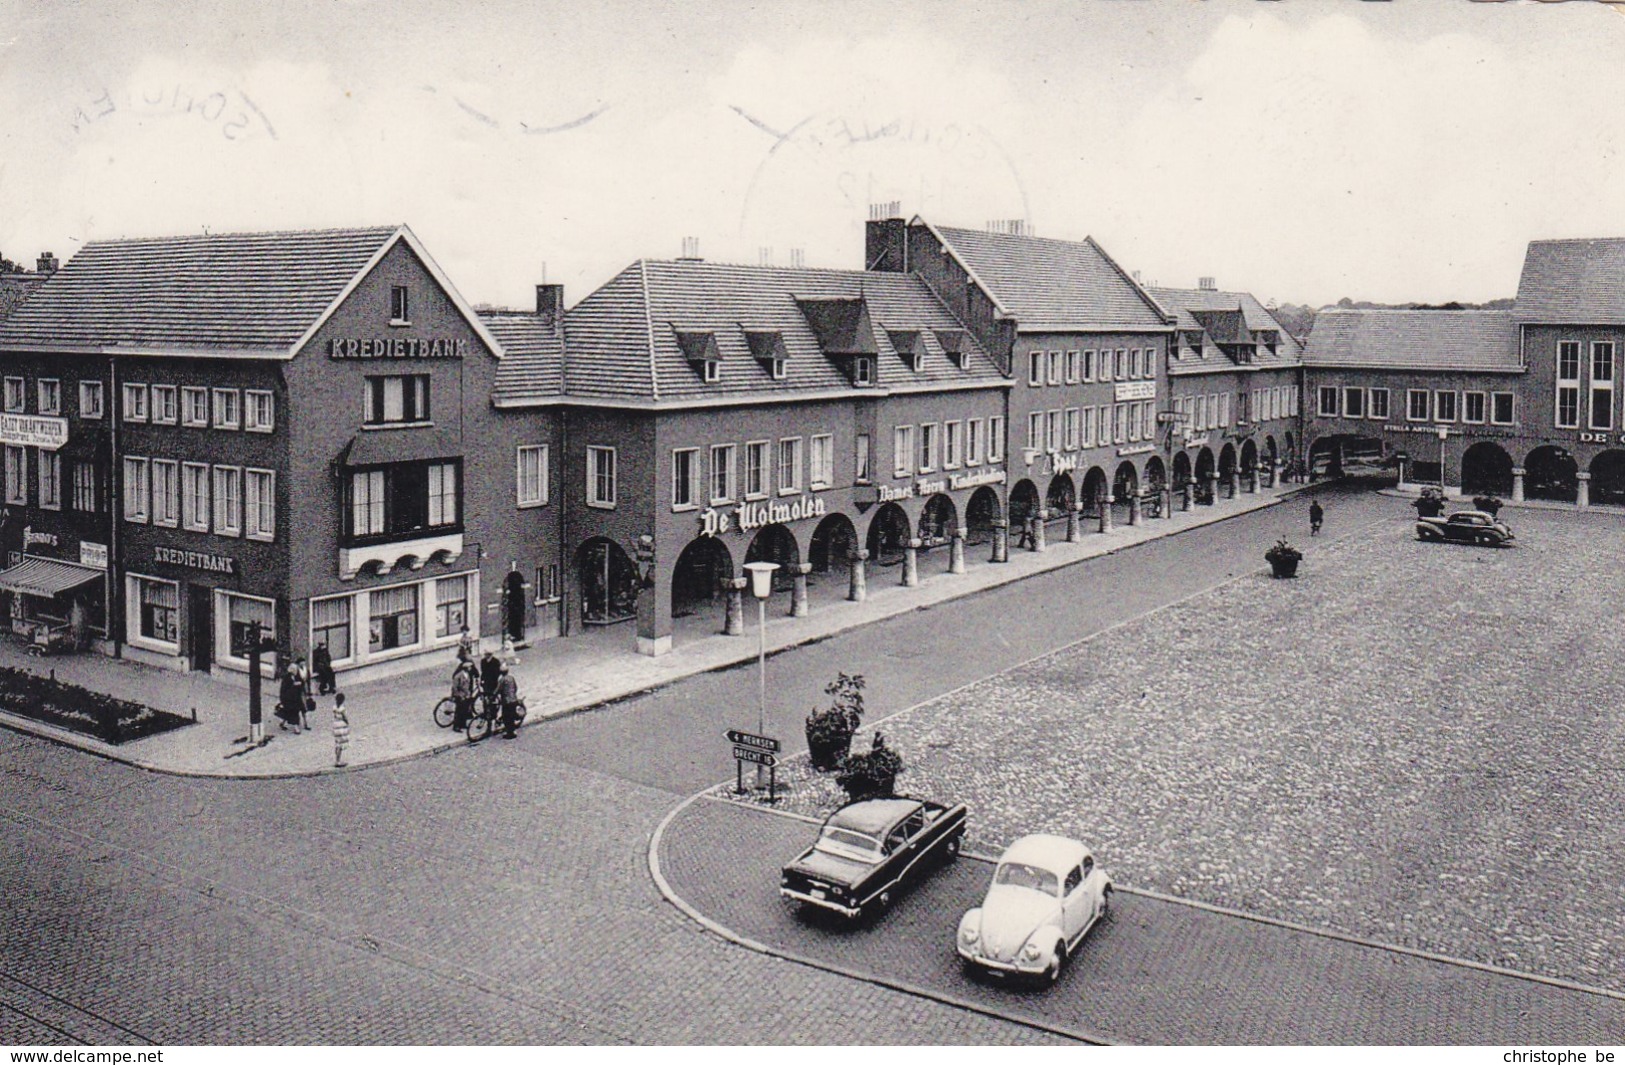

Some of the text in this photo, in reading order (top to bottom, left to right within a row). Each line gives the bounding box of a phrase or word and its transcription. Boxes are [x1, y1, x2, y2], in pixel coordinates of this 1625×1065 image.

[332, 339, 466, 357] KREDIETBANK
[1580, 432, 1607, 442] DE
[701, 507, 729, 538] De
[154, 546, 233, 573] KREDIETBANK
[735, 749, 760, 761] BRECHT
